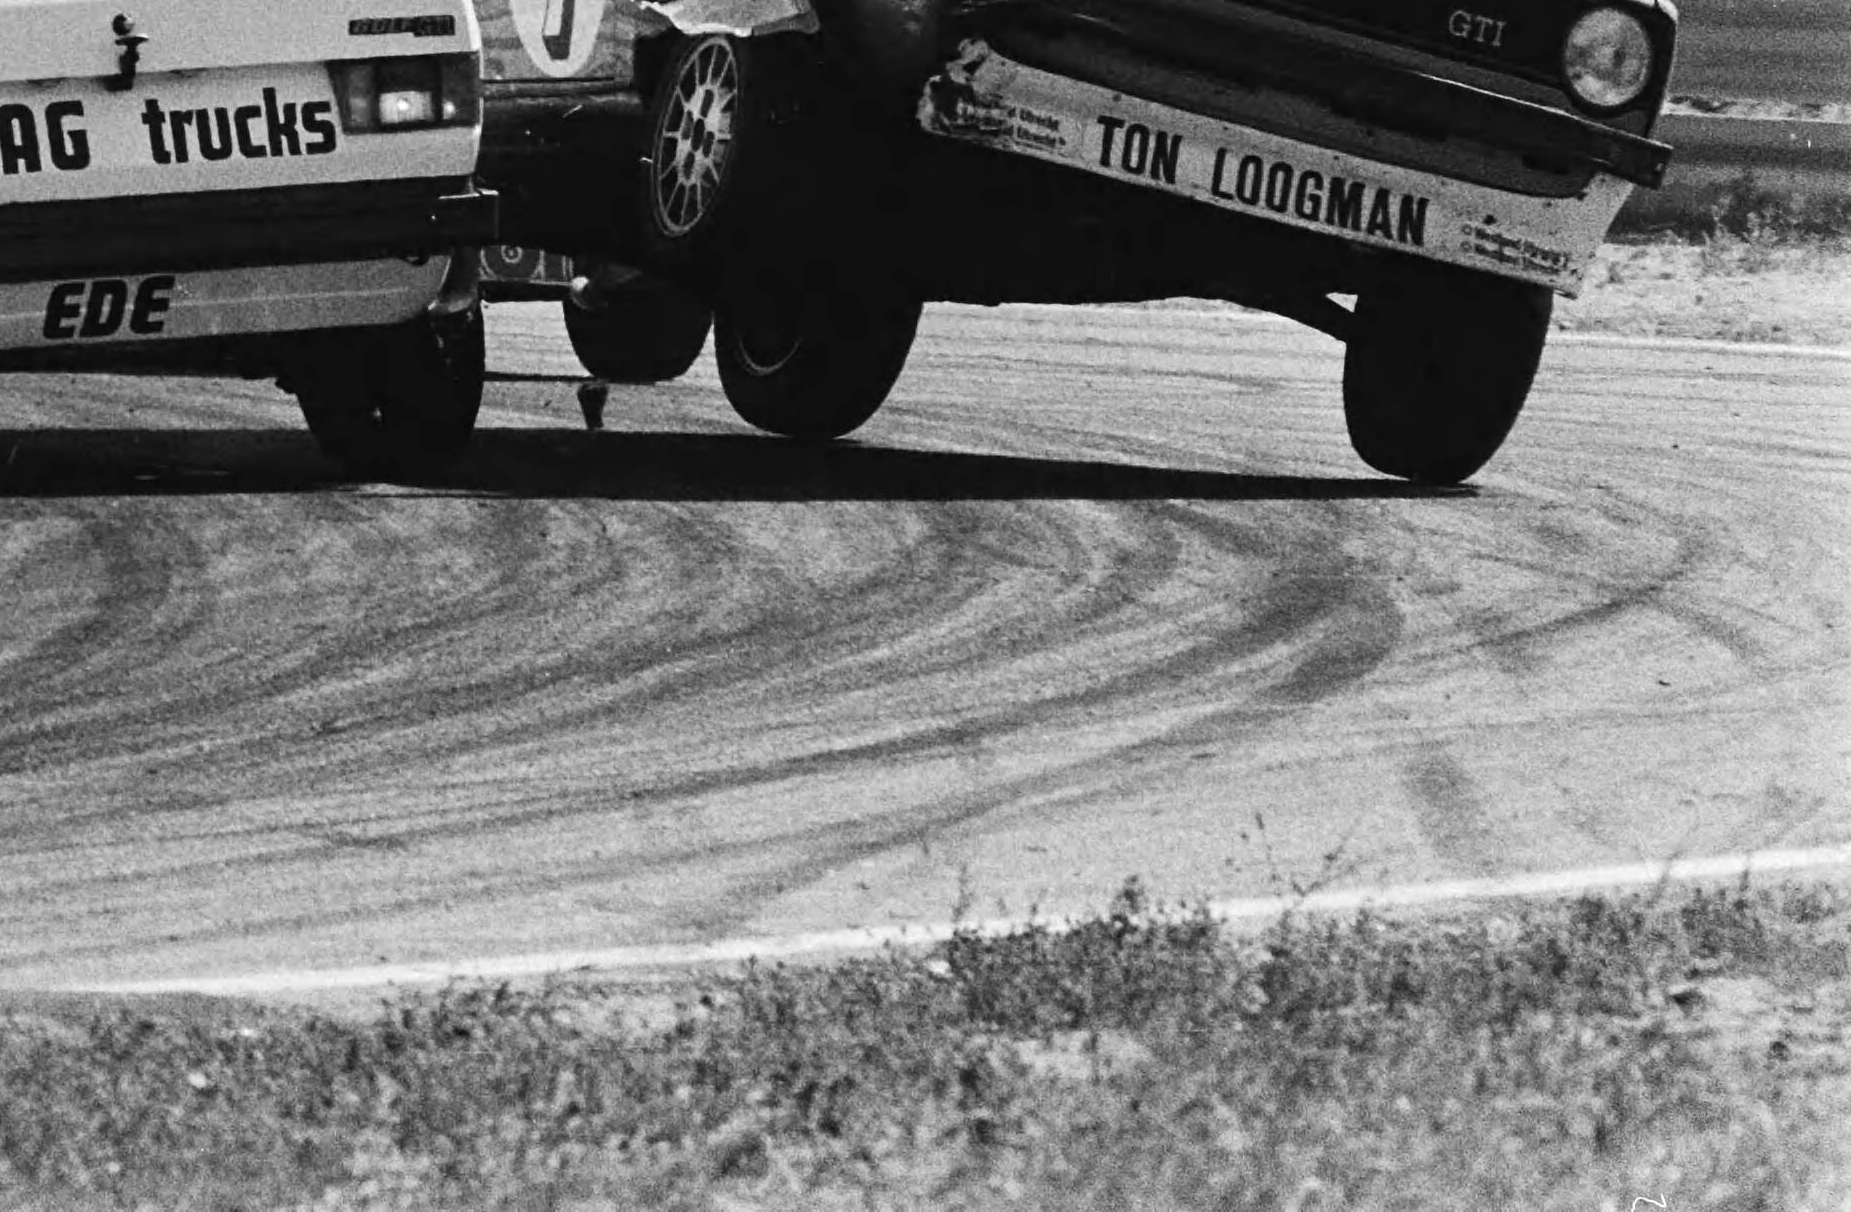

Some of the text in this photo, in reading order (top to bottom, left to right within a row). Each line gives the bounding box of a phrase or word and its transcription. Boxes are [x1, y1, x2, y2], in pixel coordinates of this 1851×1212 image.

[1449, 9, 1508, 48] GTI
[142, 87, 337, 165] trucks
[1097, 115, 1430, 247] TON LOOGMAN
[42, 275, 176, 340] EDE
